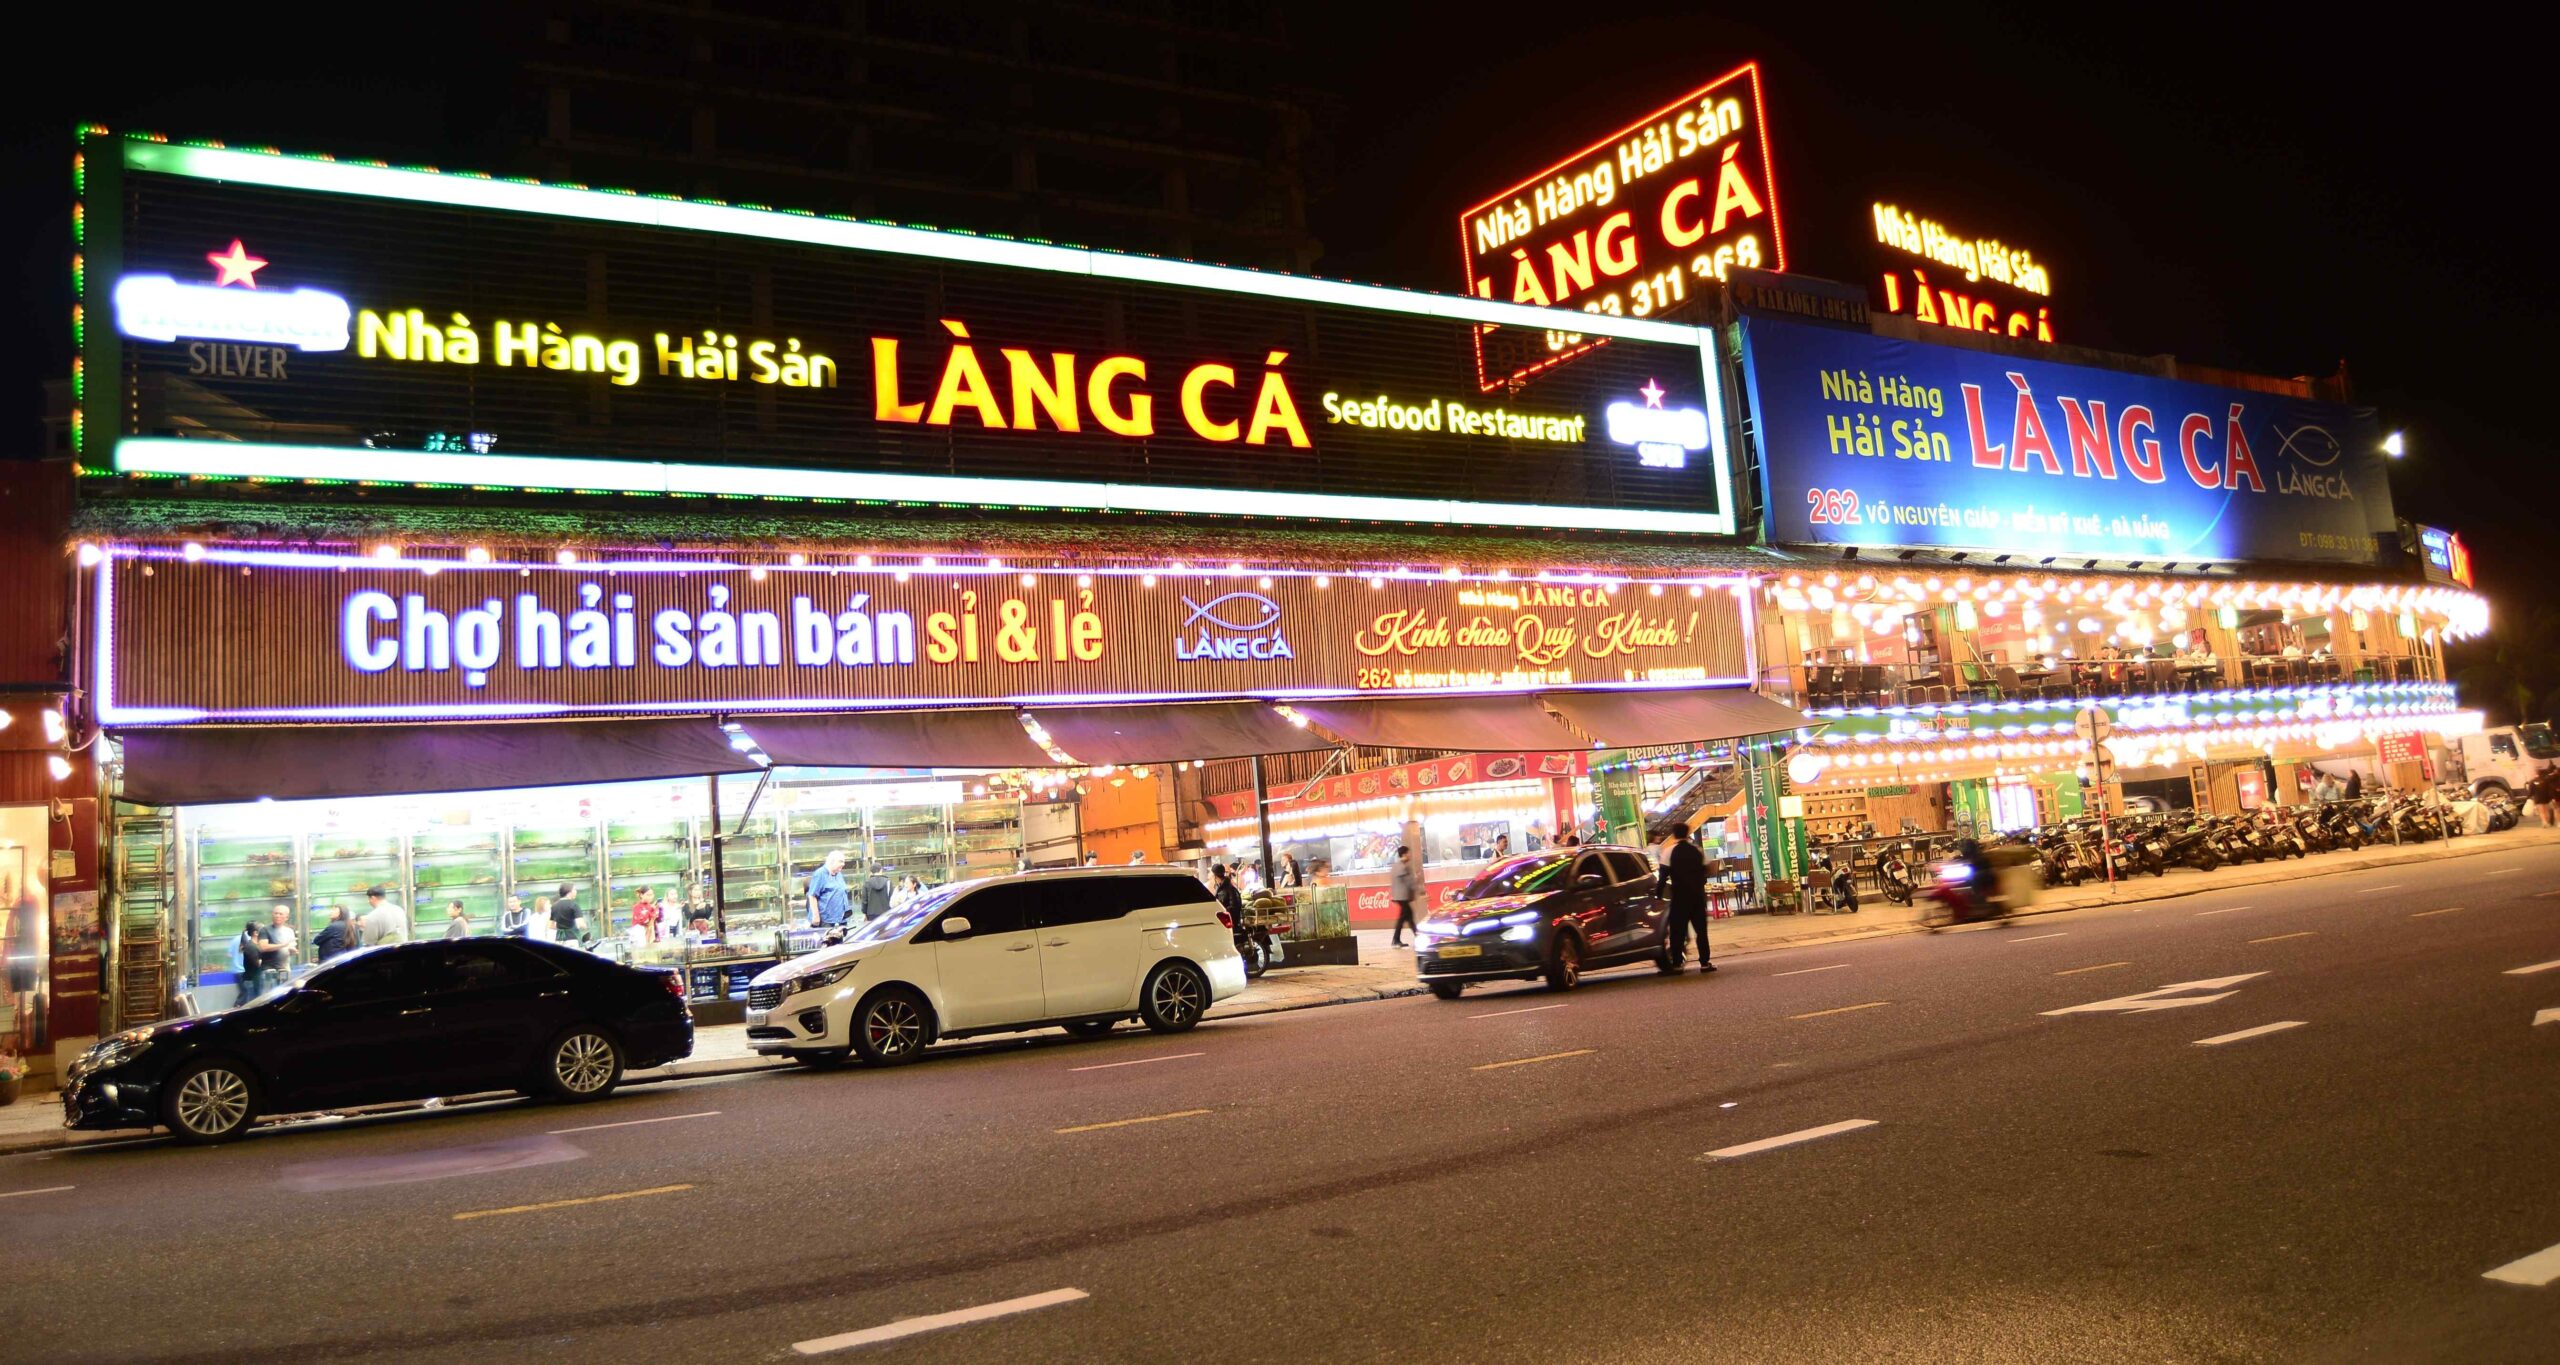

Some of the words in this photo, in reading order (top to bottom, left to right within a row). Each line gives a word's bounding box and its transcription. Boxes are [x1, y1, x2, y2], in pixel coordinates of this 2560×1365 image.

[1475, 199, 1532, 255] Nhà
[1533, 160, 1615, 226] Hàng
[1617, 122, 1674, 185] Hải
[1675, 97, 1743, 157] Sản
[1660, 141, 1764, 248] CÁ
[1873, 201, 1923, 255] Nhà
[1920, 218, 1980, 283] Hàng
[1976, 238, 2013, 285] Hải
[2010, 249, 2050, 297] Sản
[1630, 264, 1684, 317] 311
[189, 342, 288, 379] SILVER
[359, 309, 480, 364] Nhà
[496, 320, 640, 386] Hàng
[656, 330, 738, 380] Hải
[750, 337, 837, 389] Sản
[871, 319, 1154, 437] LÀNG
[1180, 351, 1312, 448] CÁ
[1820, 369, 1873, 405] Nhà
[1879, 376, 1943, 418] Hàng
[1322, 392, 1441, 432] Seafood
[1446, 402, 1586, 443] Restaurant
[1827, 413, 1885, 457] Hải
[1892, 418, 1951, 462] Sản
[1960, 371, 2166, 484] LÀNG
[2180, 403, 2266, 492] CÁ
[1807, 488, 1862, 525] 262
[1865, 501, 1890, 525] VÕ
[1893, 503, 1960, 528] NGUYÊN
[1963, 506, 2001, 529] GIÁP
[2074, 513, 2102, 536] KHÊ
[1520, 583, 1577, 608] LÀNG
[345, 588, 502, 688] Chợ
[517, 583, 635, 669] hải
[654, 584, 780, 669] sản
[795, 593, 916, 667] bán
[926, 590, 978, 664] sỉ
[997, 600, 1039, 664] &
[1055, 589, 1103, 663] lẻ
[1355, 608, 1451, 656] Kính
[1456, 616, 1512, 647] chào
[1513, 613, 1577, 665] Quý
[1584, 610, 1678, 659] Khách
[1358, 668, 1392, 689] 262
[1593, 782, 1605, 812] SILVER
[1780, 762, 1792, 796] SILVER
[1759, 824, 1773, 882] eineken
